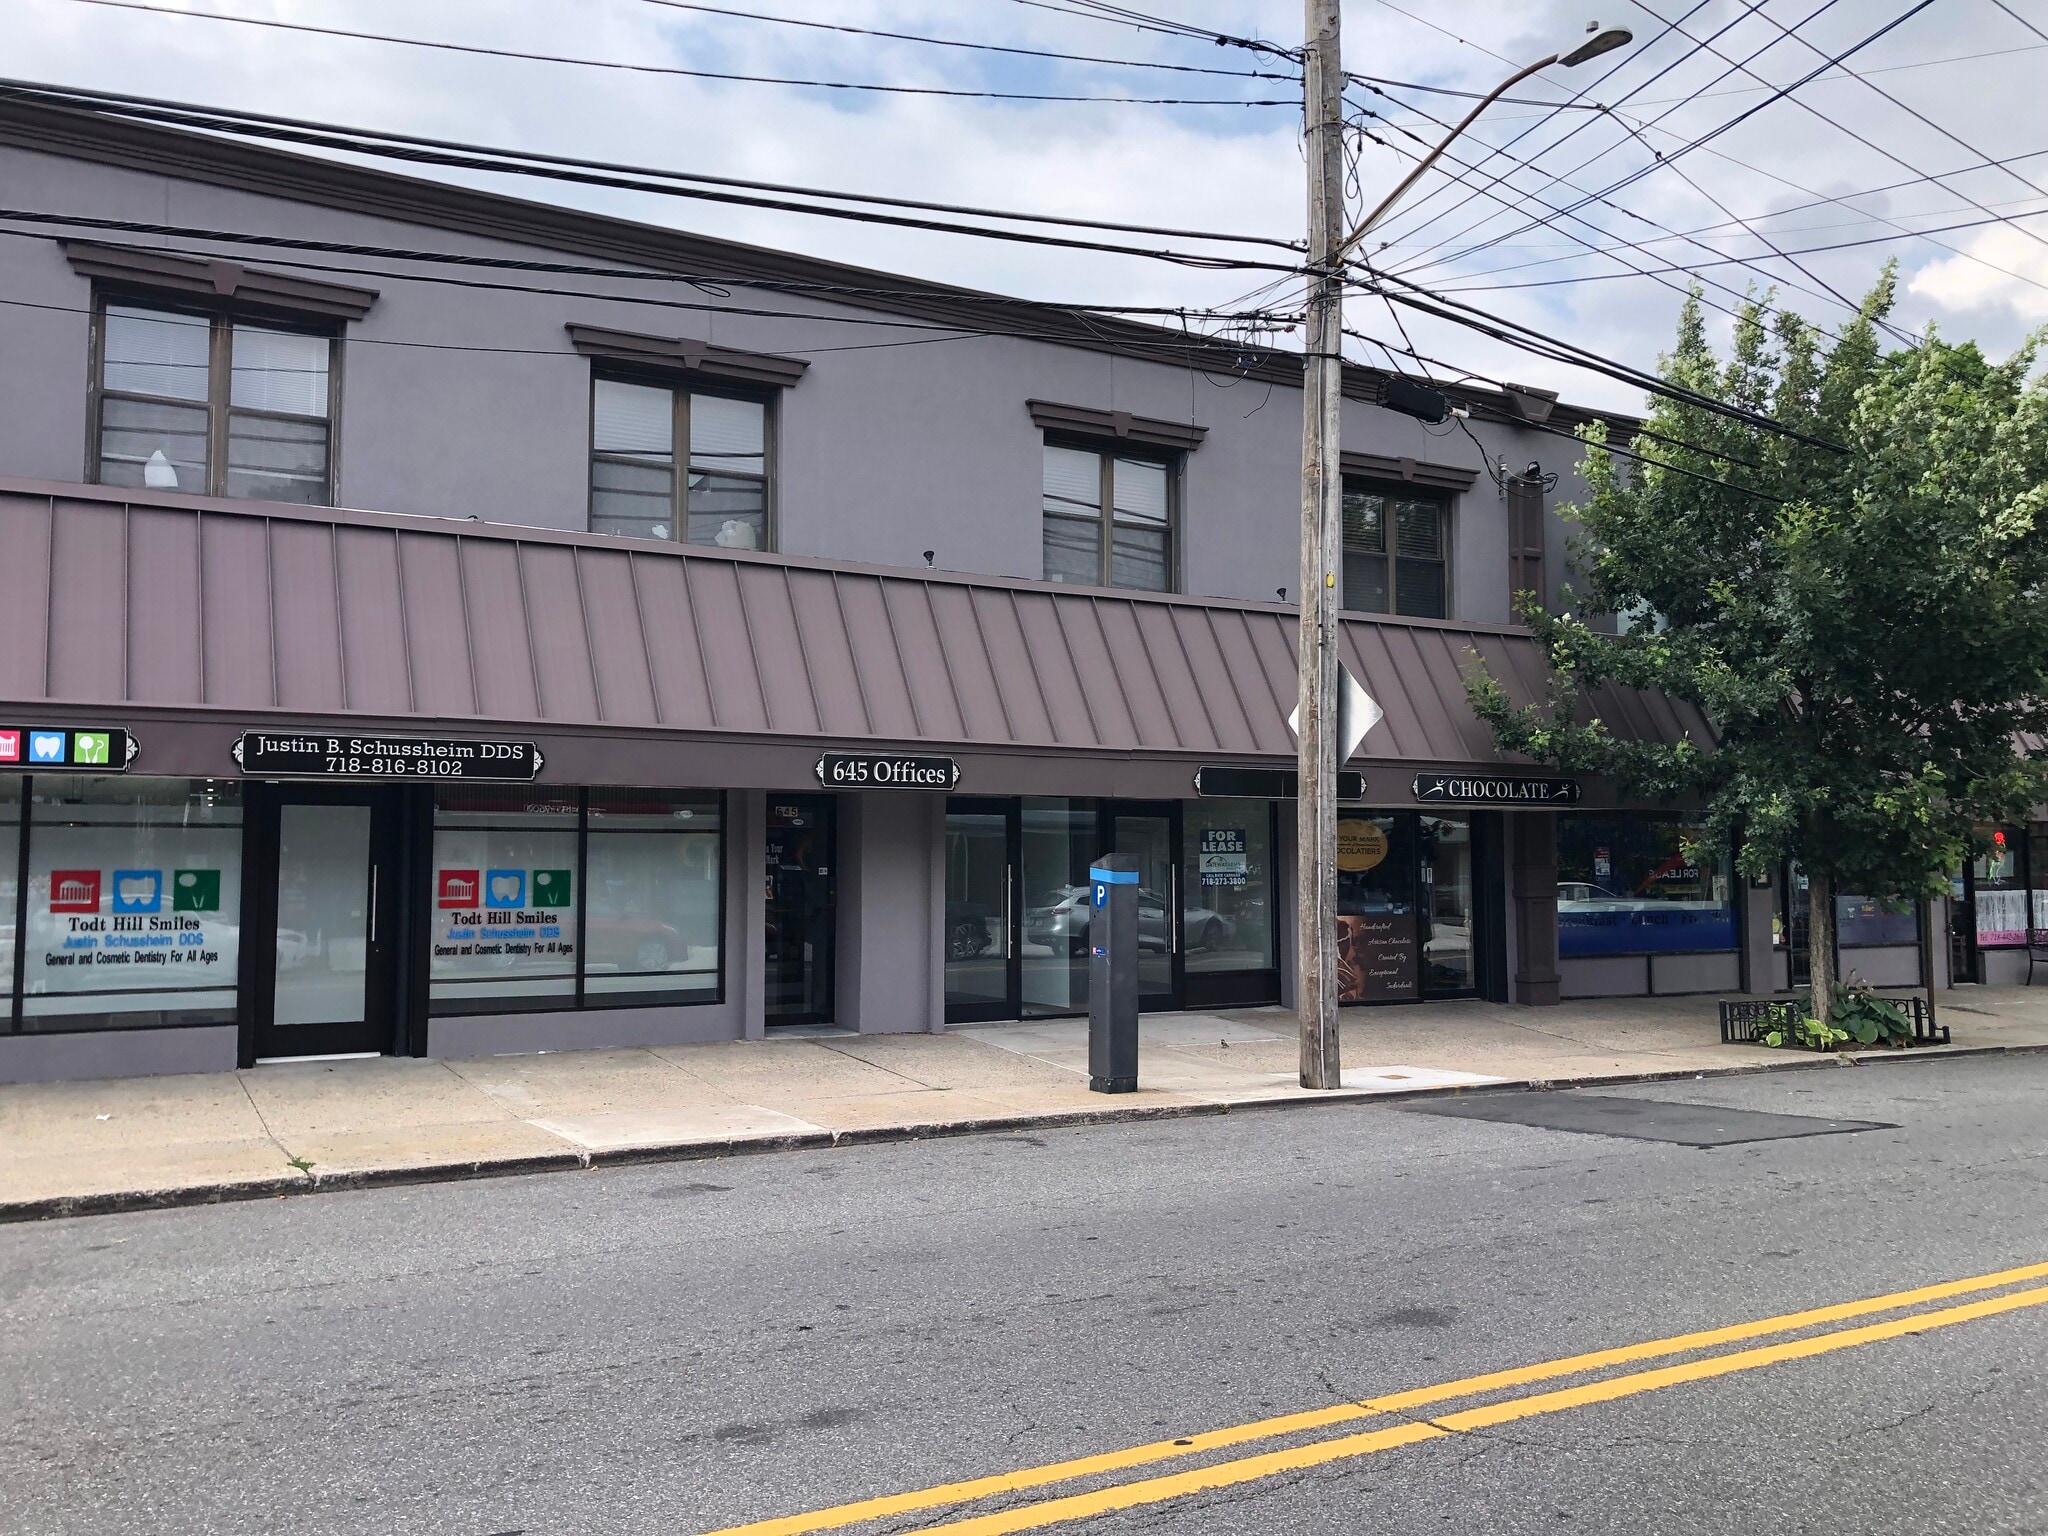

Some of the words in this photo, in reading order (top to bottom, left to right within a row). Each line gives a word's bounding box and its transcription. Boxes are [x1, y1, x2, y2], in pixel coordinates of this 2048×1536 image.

[256, 736, 320, 756] Justin
[326, 739, 344, 754] B.
[350, 739, 475, 758] Schussheim
[480, 744, 524, 760] DDS
[326, 757, 463, 775] 718-816-8102
[833, 760, 868, 781] 645
[873, 761, 946, 784] Offices
[1449, 779, 1550, 799] CHOCOLATE
[776, 807, 798, 816] 645
[1208, 830, 1237, 841] FOR
[1202, 841, 1244, 852] LEASE
[1337, 847, 1381, 855] OCOLATIERS
[1201, 877, 1246, 886] 718-273-3800
[1097, 885, 1105, 905] P
[69, 916, 106, 931] Todt
[113, 916, 143, 931] Hill
[149, 915, 200, 931] Smiles
[451, 911, 482, 925] Todt
[487, 911, 512, 924] Hill
[516, 910, 558, 924] Smiles
[63, 935, 98, 949] Justin
[104, 933, 173, 948] Schussheim
[178, 932, 204, 946] DDS
[447, 928, 475, 940] Justin
[480, 926, 535, 939] Schussheim
[540, 926, 560, 938] DDS
[434, 944, 458, 956] General
[461, 944, 472, 955] and
[475, 943, 502, 955] Cosmetic
[505, 943, 532, 956] Dentistry
[535, 942, 545, 953] For
[547, 942, 555, 953] All
[558, 942, 573, 955] Ages
[46, 952, 75, 966] General
[79, 952, 93, 965] and
[96, 951, 131, 964] Cosmetic
[135, 950, 167, 966] Dentistry
[171, 950, 183, 962] For
[187, 950, 197, 961] All
[200, 950, 218, 965] Ages
